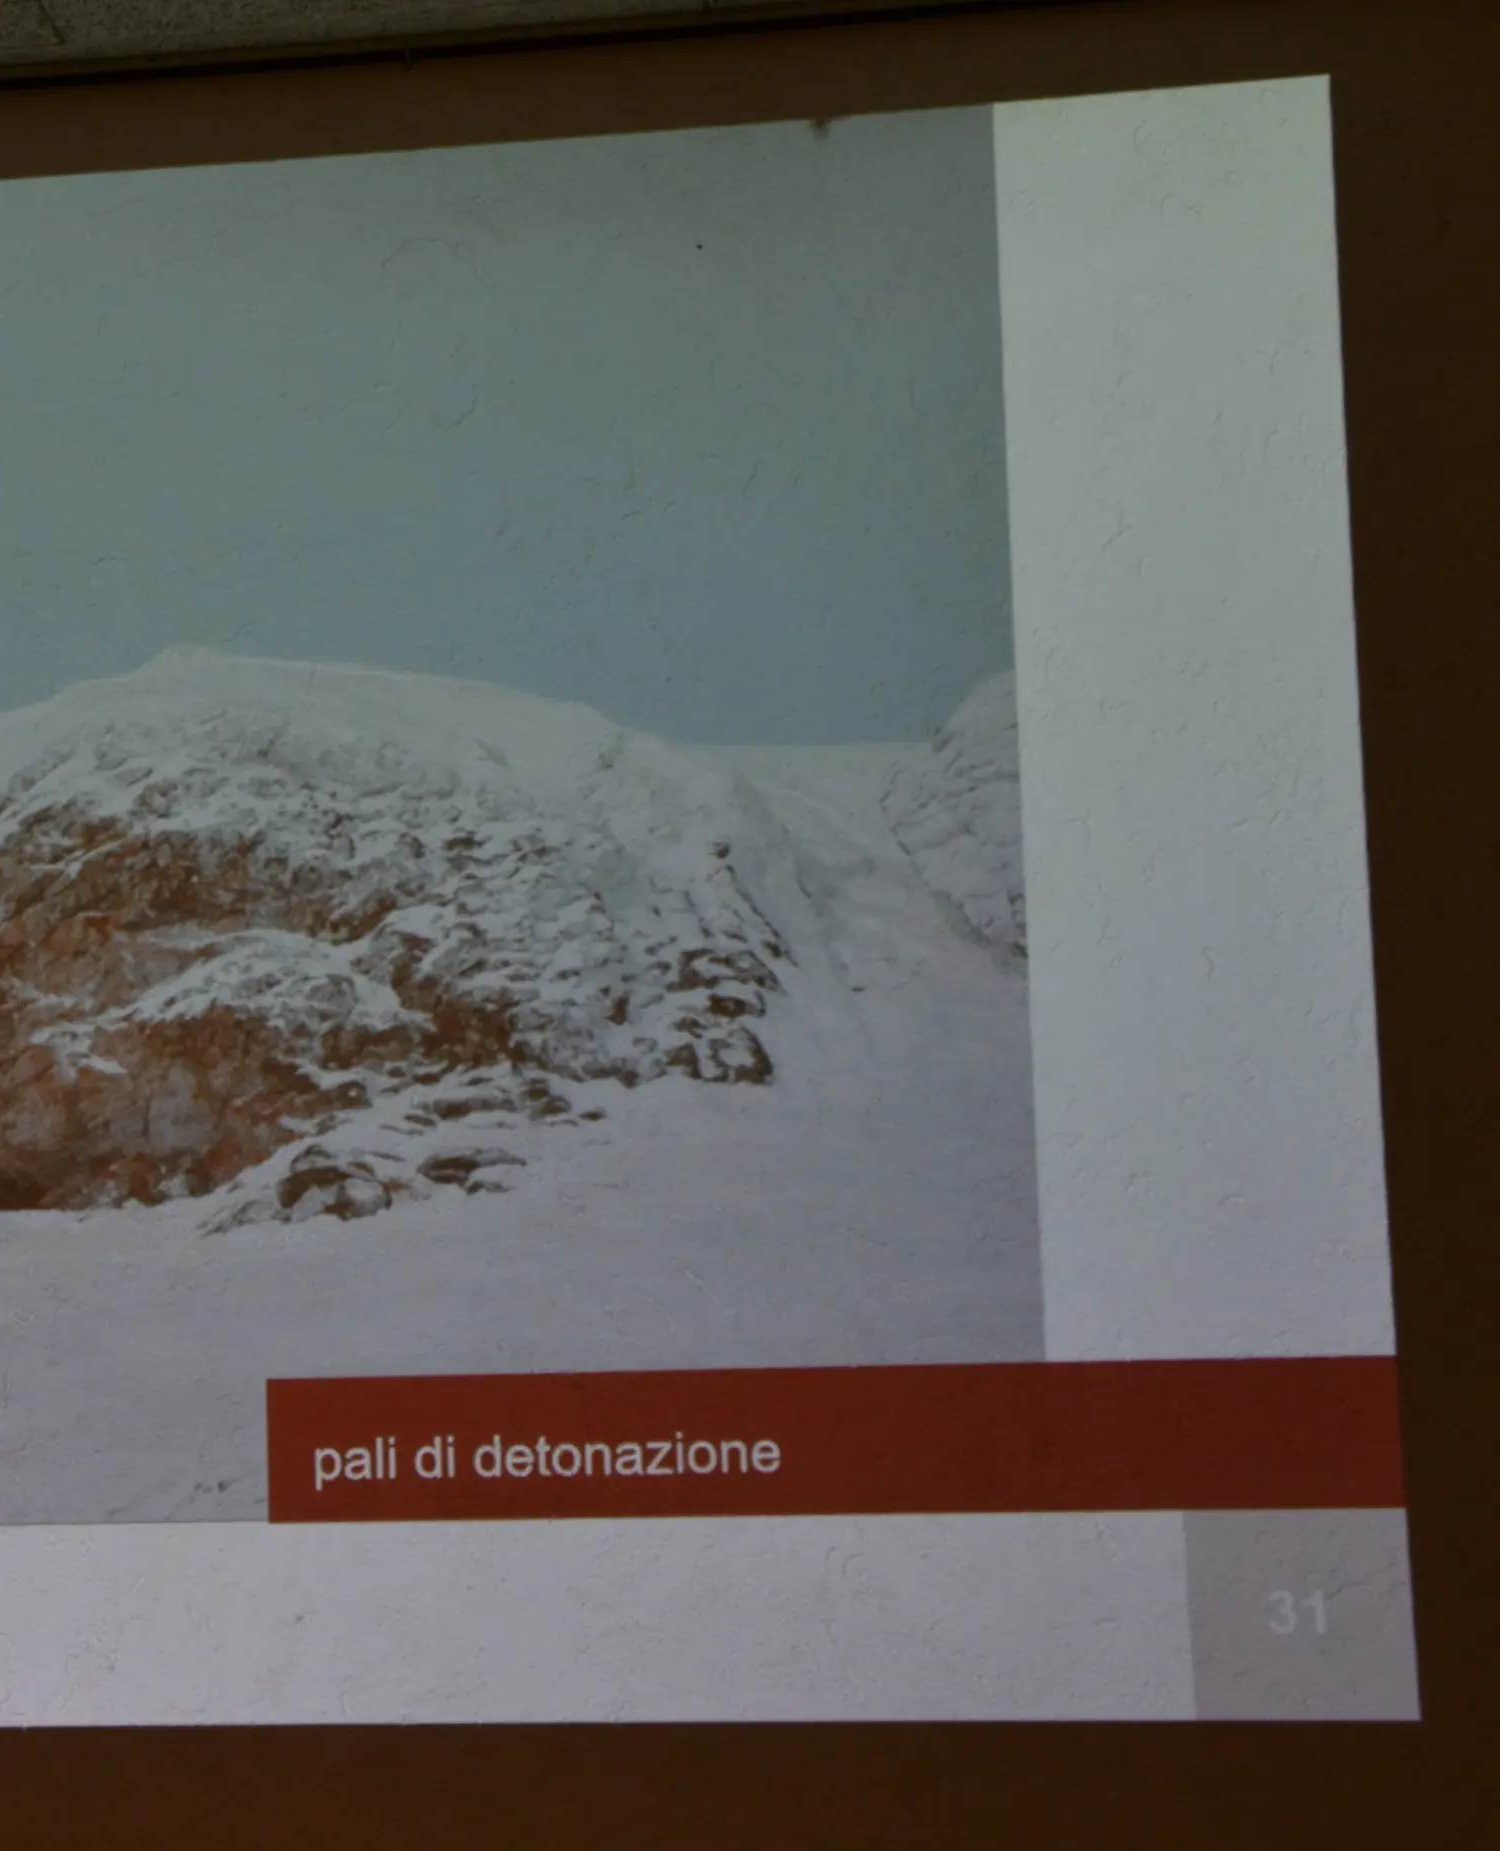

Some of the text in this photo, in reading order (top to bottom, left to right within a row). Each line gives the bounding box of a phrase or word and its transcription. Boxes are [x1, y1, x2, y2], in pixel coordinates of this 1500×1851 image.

[313, 1431, 782, 1491] pali di detonazione
[1268, 1588, 1327, 1635] 31
